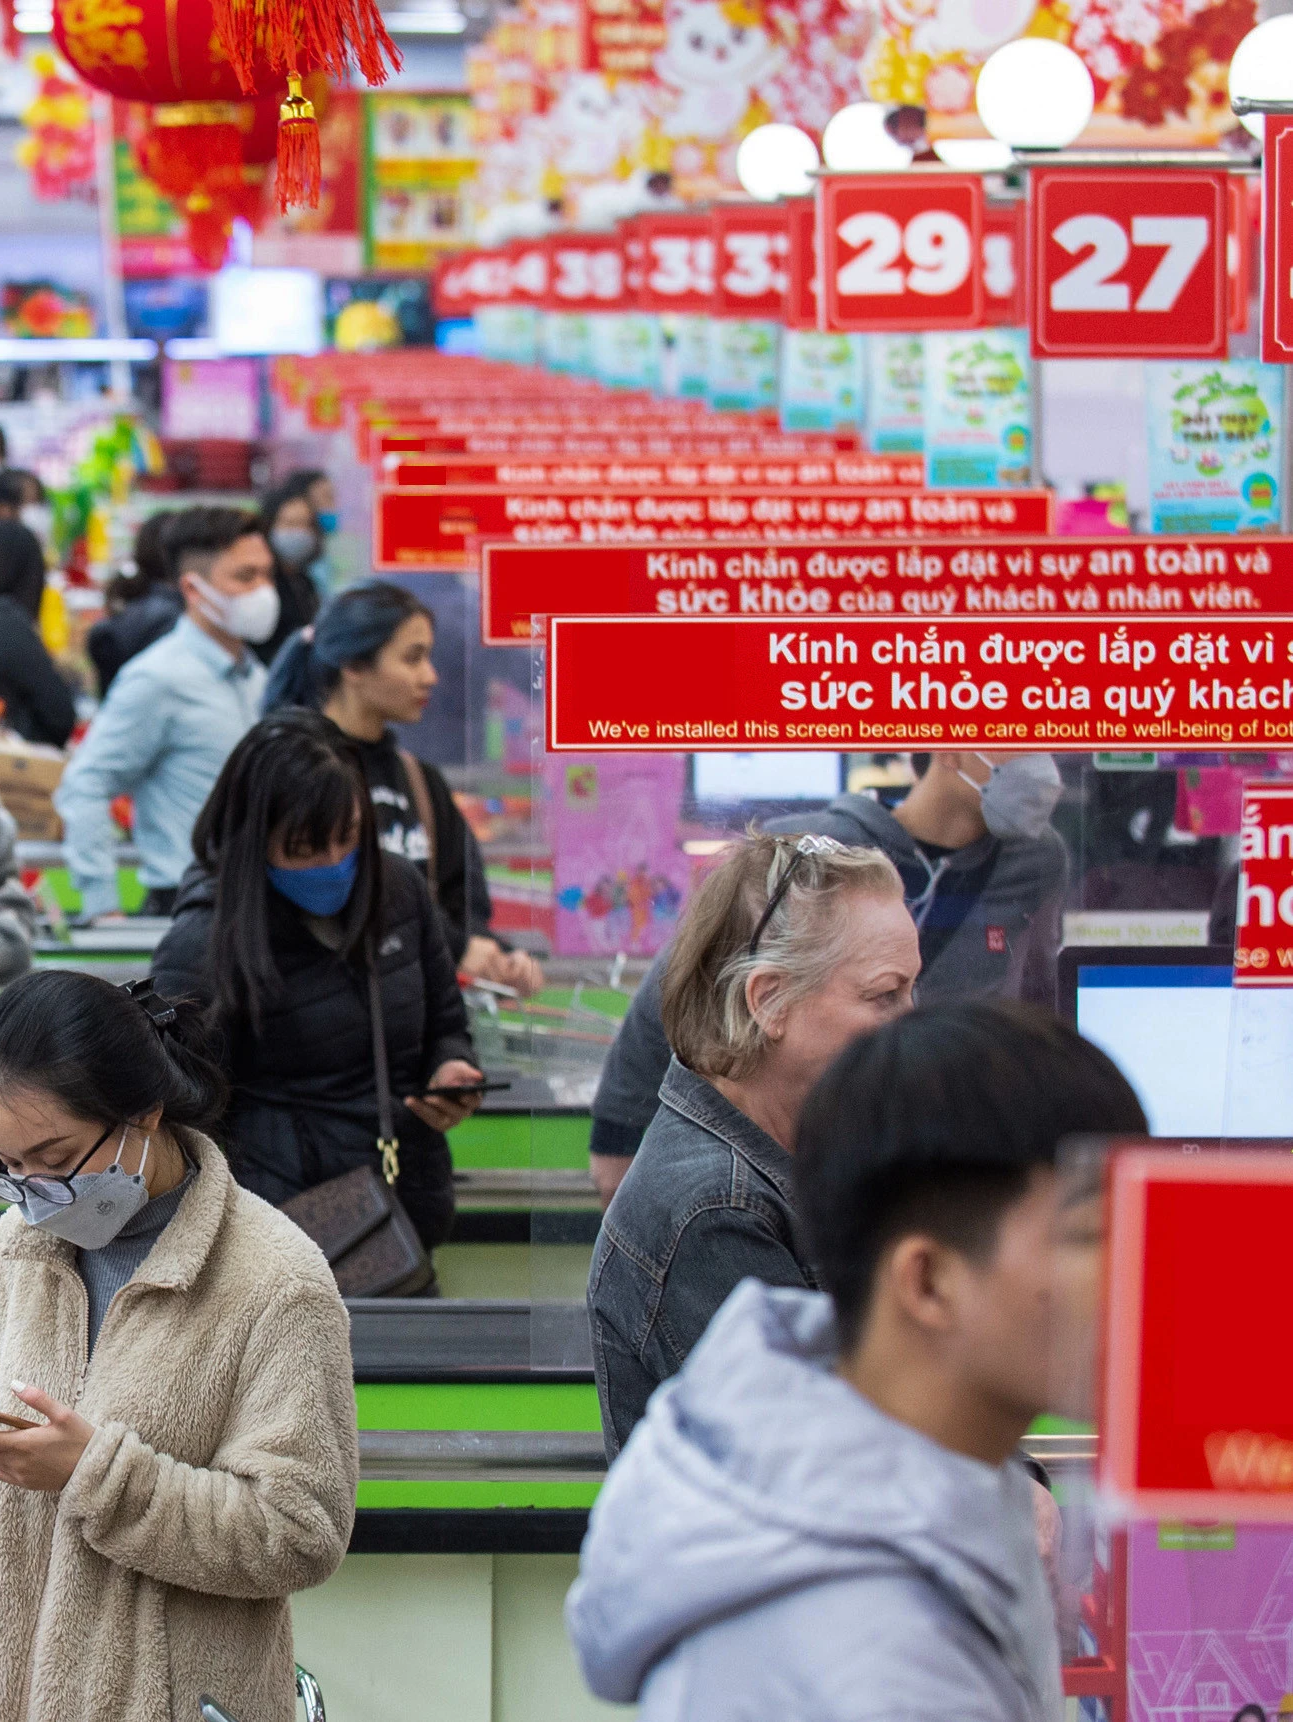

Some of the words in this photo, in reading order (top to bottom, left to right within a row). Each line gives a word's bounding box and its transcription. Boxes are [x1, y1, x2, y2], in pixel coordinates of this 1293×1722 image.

[724, 233, 788, 296] 3
[837, 210, 971, 296] 29
[1050, 214, 1208, 311] 27
[647, 552, 717, 579] Kính
[725, 546, 798, 579] chắn
[806, 551, 890, 583] được
[897, 546, 942, 582] lắp
[950, 549, 999, 581] đặt
[1005, 549, 1033, 576] vì
[1040, 553, 1084, 581] sự
[1089, 550, 1134, 576] an
[1144, 543, 1228, 576] toàn
[1234, 547, 1272, 575] và
[656, 581, 731, 613] sức
[739, 578, 833, 613] khỏe
[839, 584, 893, 611] của
[965, 582, 1057, 611] khách
[1062, 582, 1100, 610] và
[1107, 582, 1182, 610] nhân
[769, 632, 857, 664] Kính
[871, 626, 965, 664] chắn
[979, 633, 1085, 671] được
[1099, 626, 1156, 671] lắp
[1169, 632, 1230, 670] đặt
[1241, 632, 1274, 664] vì
[780, 671, 875, 711] sức
[891, 671, 1008, 711] khỏe
[1021, 677, 1091, 711] của
[1104, 678, 1176, 717] quý
[589, 720, 649, 738] We've
[656, 720, 738, 738] installed
[744, 720, 779, 738] this
[786, 724, 852, 738] screen
[859, 720, 943, 738] because
[950, 724, 978, 738] we
[984, 724, 1028, 738] care
[1034, 720, 1090, 738] about
[1096, 720, 1127, 738] the
[1133, 720, 1233, 742] well-being
[1239, 720, 1259, 738] of
